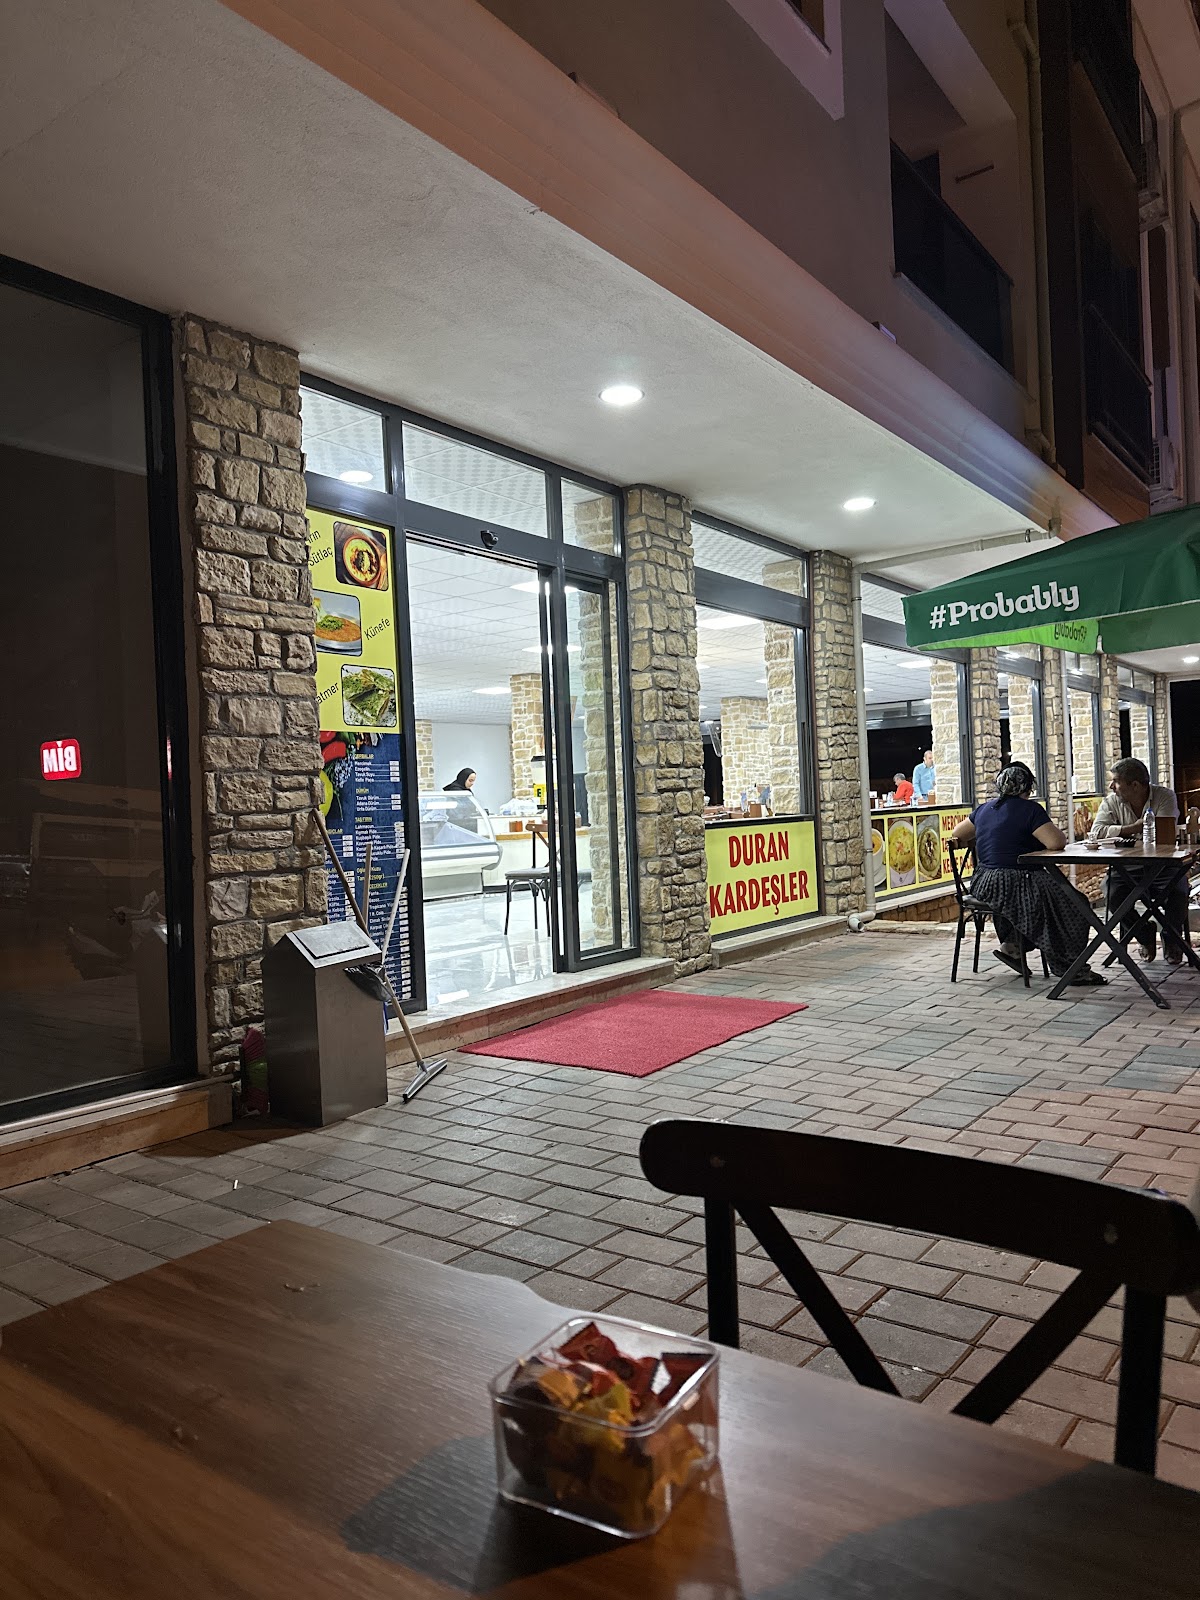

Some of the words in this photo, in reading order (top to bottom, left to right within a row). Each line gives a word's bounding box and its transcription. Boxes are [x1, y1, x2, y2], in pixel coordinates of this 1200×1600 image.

[308, 530, 321, 544] ırın
[929, 581, 1080, 629] #Probably
[364, 617, 391, 641] Künefe
[316, 682, 339, 704] atmer
[728, 831, 789, 868] DURAN
[709, 870, 810, 918] KARDEŞLER
